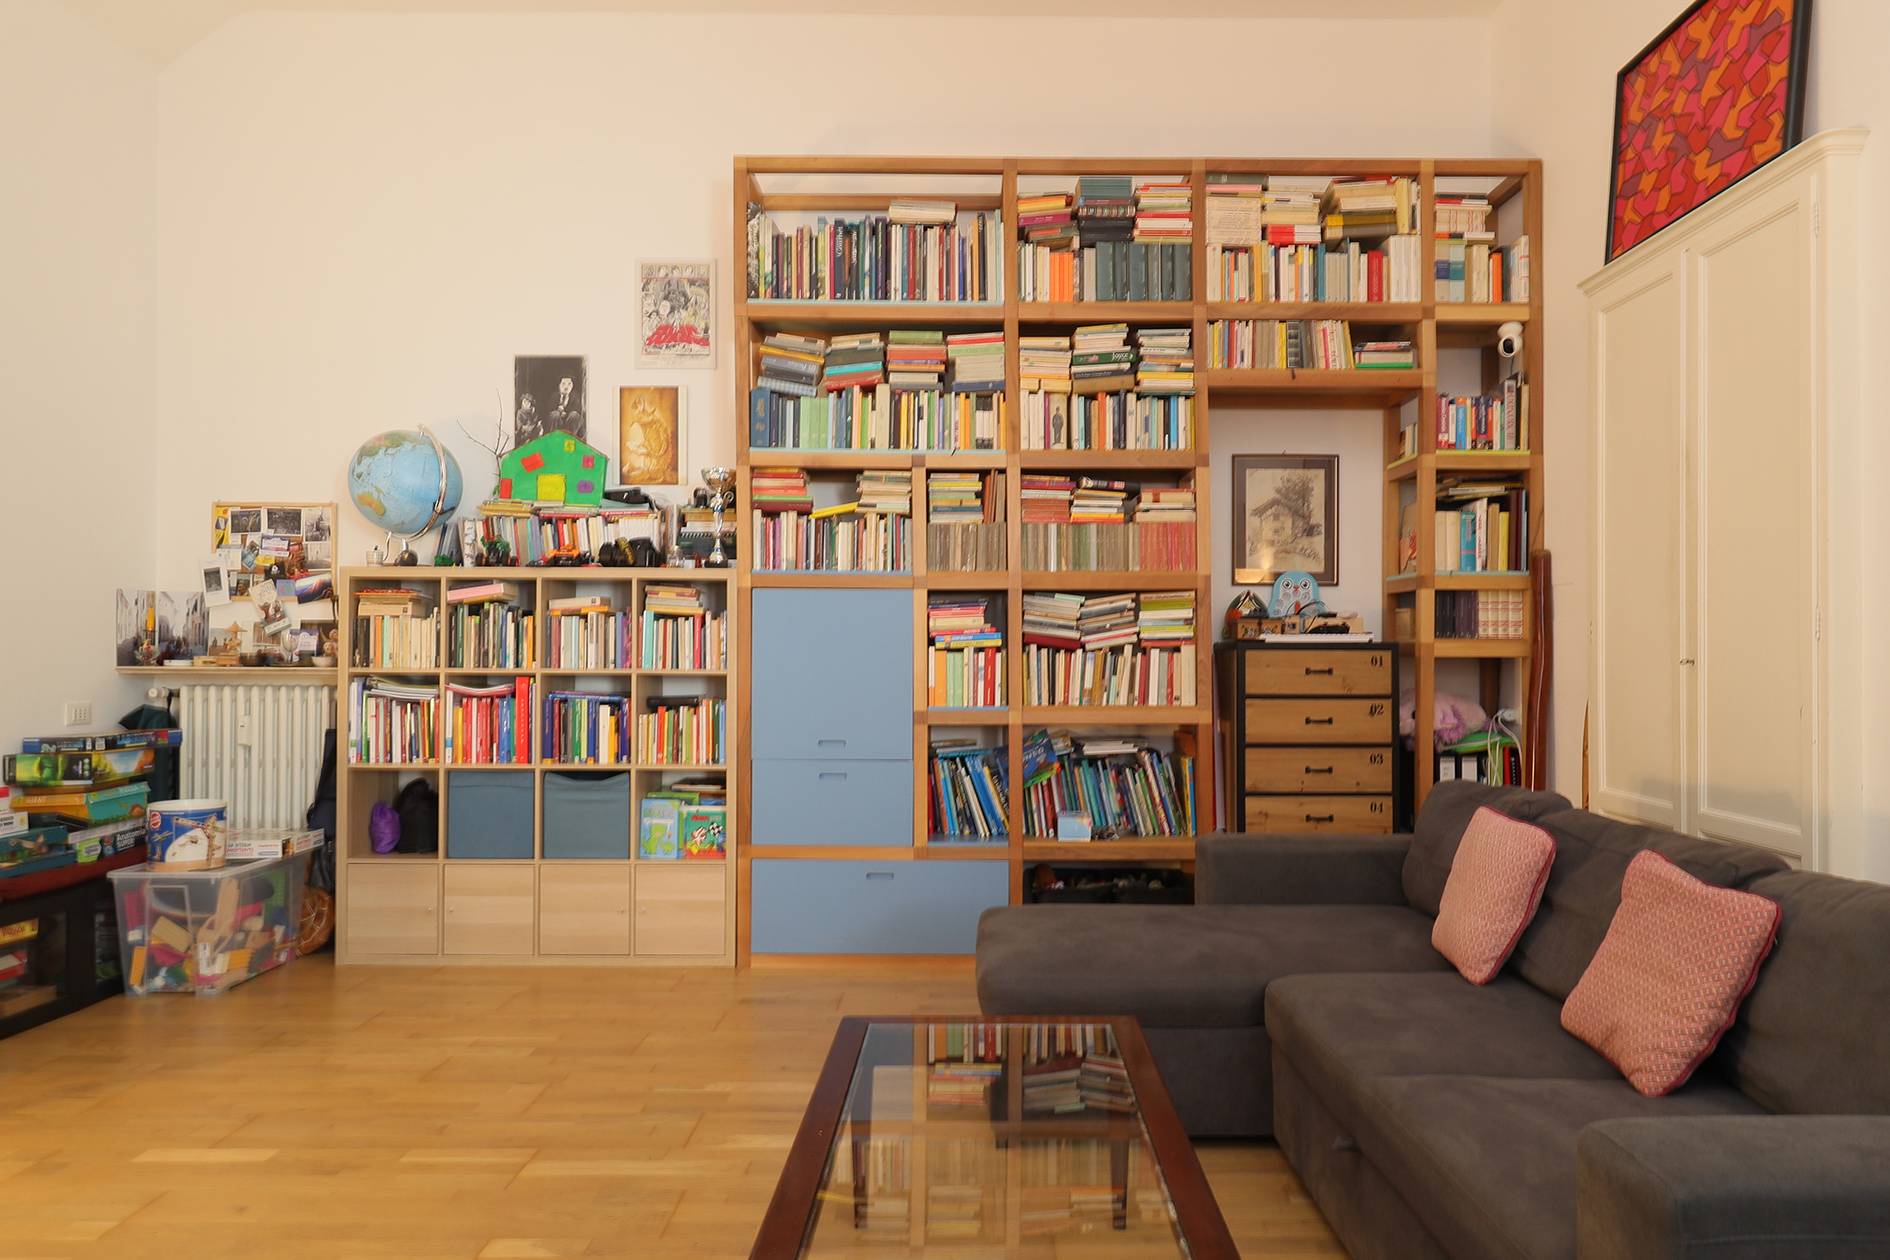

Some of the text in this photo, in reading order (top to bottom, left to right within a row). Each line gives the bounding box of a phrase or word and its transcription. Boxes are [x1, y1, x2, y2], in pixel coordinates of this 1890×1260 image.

[1370, 655, 1384, 668] 01
[1369, 704, 1384, 716] 02
[1369, 752, 1385, 766] 03
